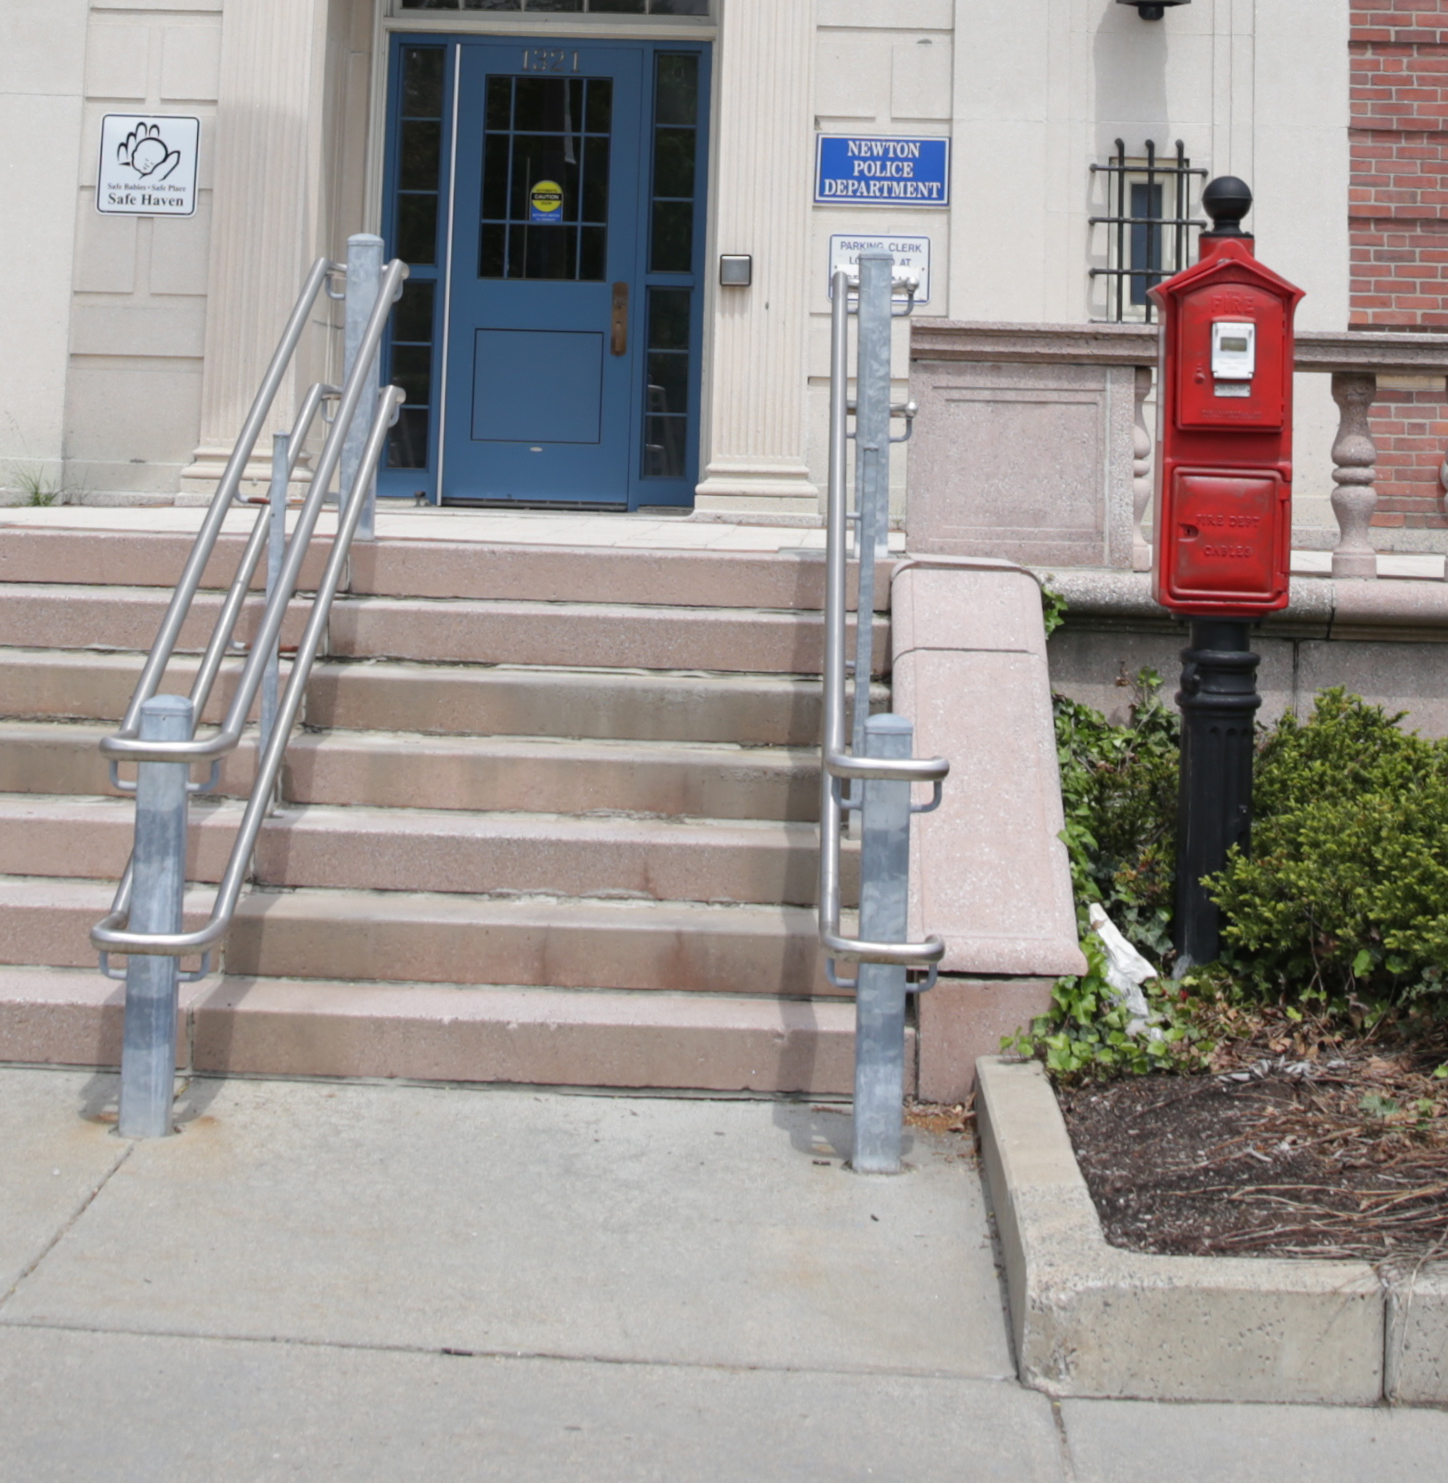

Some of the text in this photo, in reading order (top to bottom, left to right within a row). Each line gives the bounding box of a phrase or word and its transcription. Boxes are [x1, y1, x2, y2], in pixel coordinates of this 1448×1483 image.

[520, 48, 581, 74] 1321
[847, 140, 921, 158] NEWTON
[853, 160, 914, 178] POLICE
[107, 182, 186, 192] Safe Babies Safe Place
[823, 179, 941, 199] DEPARTMENT
[107, 192, 184, 207] Safe Haven
[888, 242, 922, 253] CLERK
[899, 258, 912, 266] AT
[1211, 294, 1255, 314] FIRE
[1195, 513, 1260, 528] FIRE DEPT
[1203, 544, 1252, 558] CABLES
